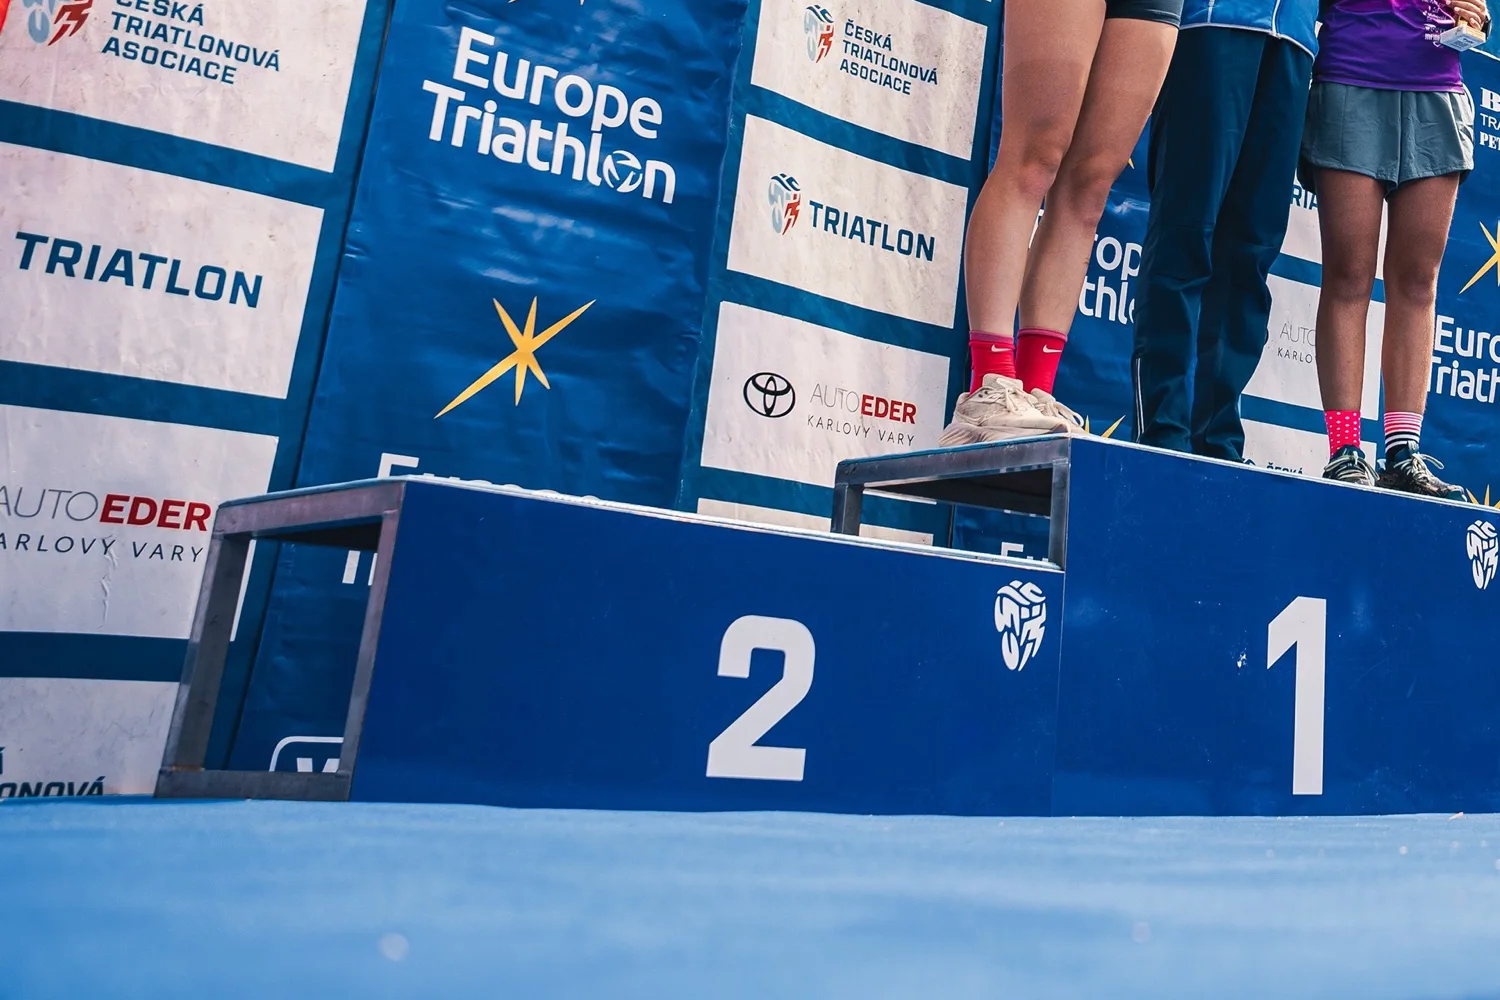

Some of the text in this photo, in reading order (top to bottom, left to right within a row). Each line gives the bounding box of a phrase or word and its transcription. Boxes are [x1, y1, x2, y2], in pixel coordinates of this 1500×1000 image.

[111, 12, 280, 72] TRIATLONOVÁ
[844, 18, 893, 51] ČESKÁ
[101, 36, 237, 84] ASOCIACE
[453, 26, 663, 139] Europe
[839, 58, 912, 95] ASOCIACE
[843, 40, 938, 85] TRIATLONOVÁ
[422, 79, 676, 204] Triathlon
[809, 200, 936, 262] TRIATLON
[15, 231, 263, 309] TRIATLON
[1277, 347, 1313, 364] KARLO
[1279, 322, 1316, 347] AUTO
[807, 414, 914, 447] KARLOVY VARY
[0, 533, 203, 562] ARLOVY VARY
[706, 614, 816, 781] 2
[1266, 596, 1327, 795] 1
